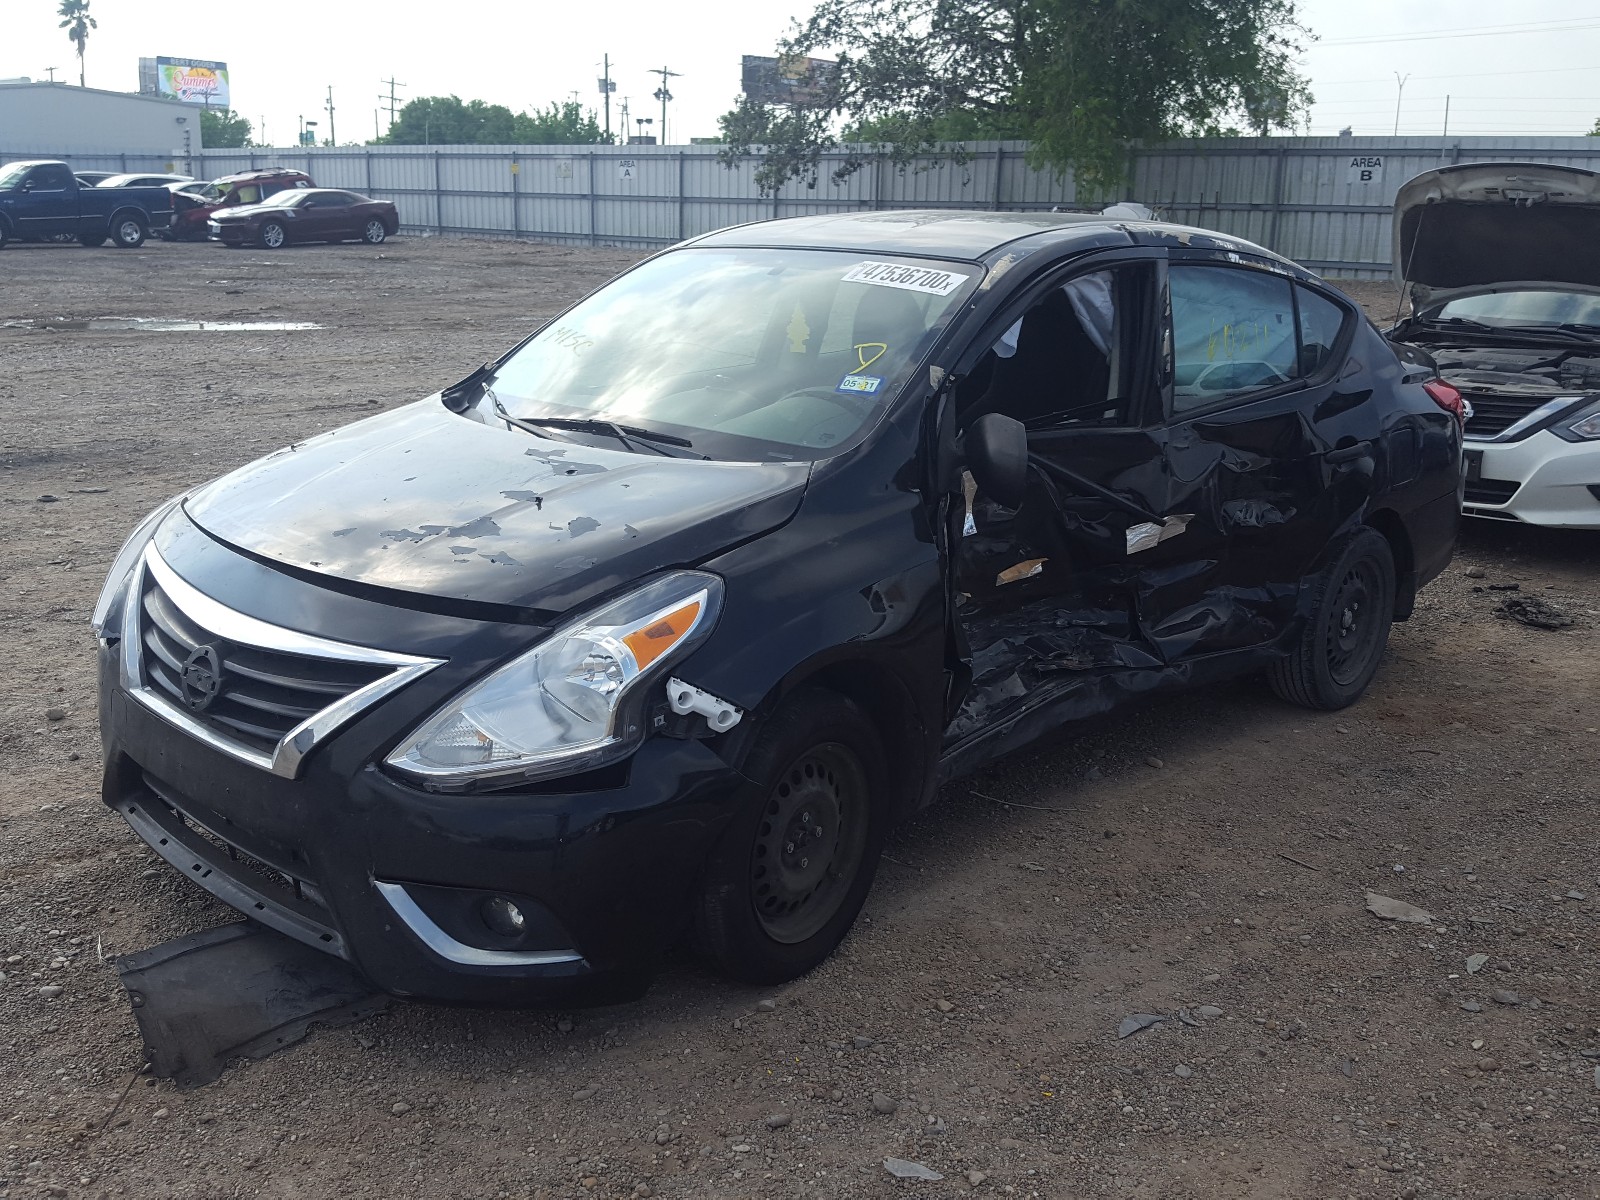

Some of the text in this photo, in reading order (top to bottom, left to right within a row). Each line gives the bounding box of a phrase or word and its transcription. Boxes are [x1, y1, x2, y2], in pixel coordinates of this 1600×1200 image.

[170, 58, 216, 68] BERT OGDEN
[173, 70, 217, 91] Summer
[619, 160, 635, 168] AREA
[1350, 157, 1382, 168] AREA
[624, 169, 631, 177] A
[1360, 170, 1373, 181] B
[843, 379, 858, 388] 05
